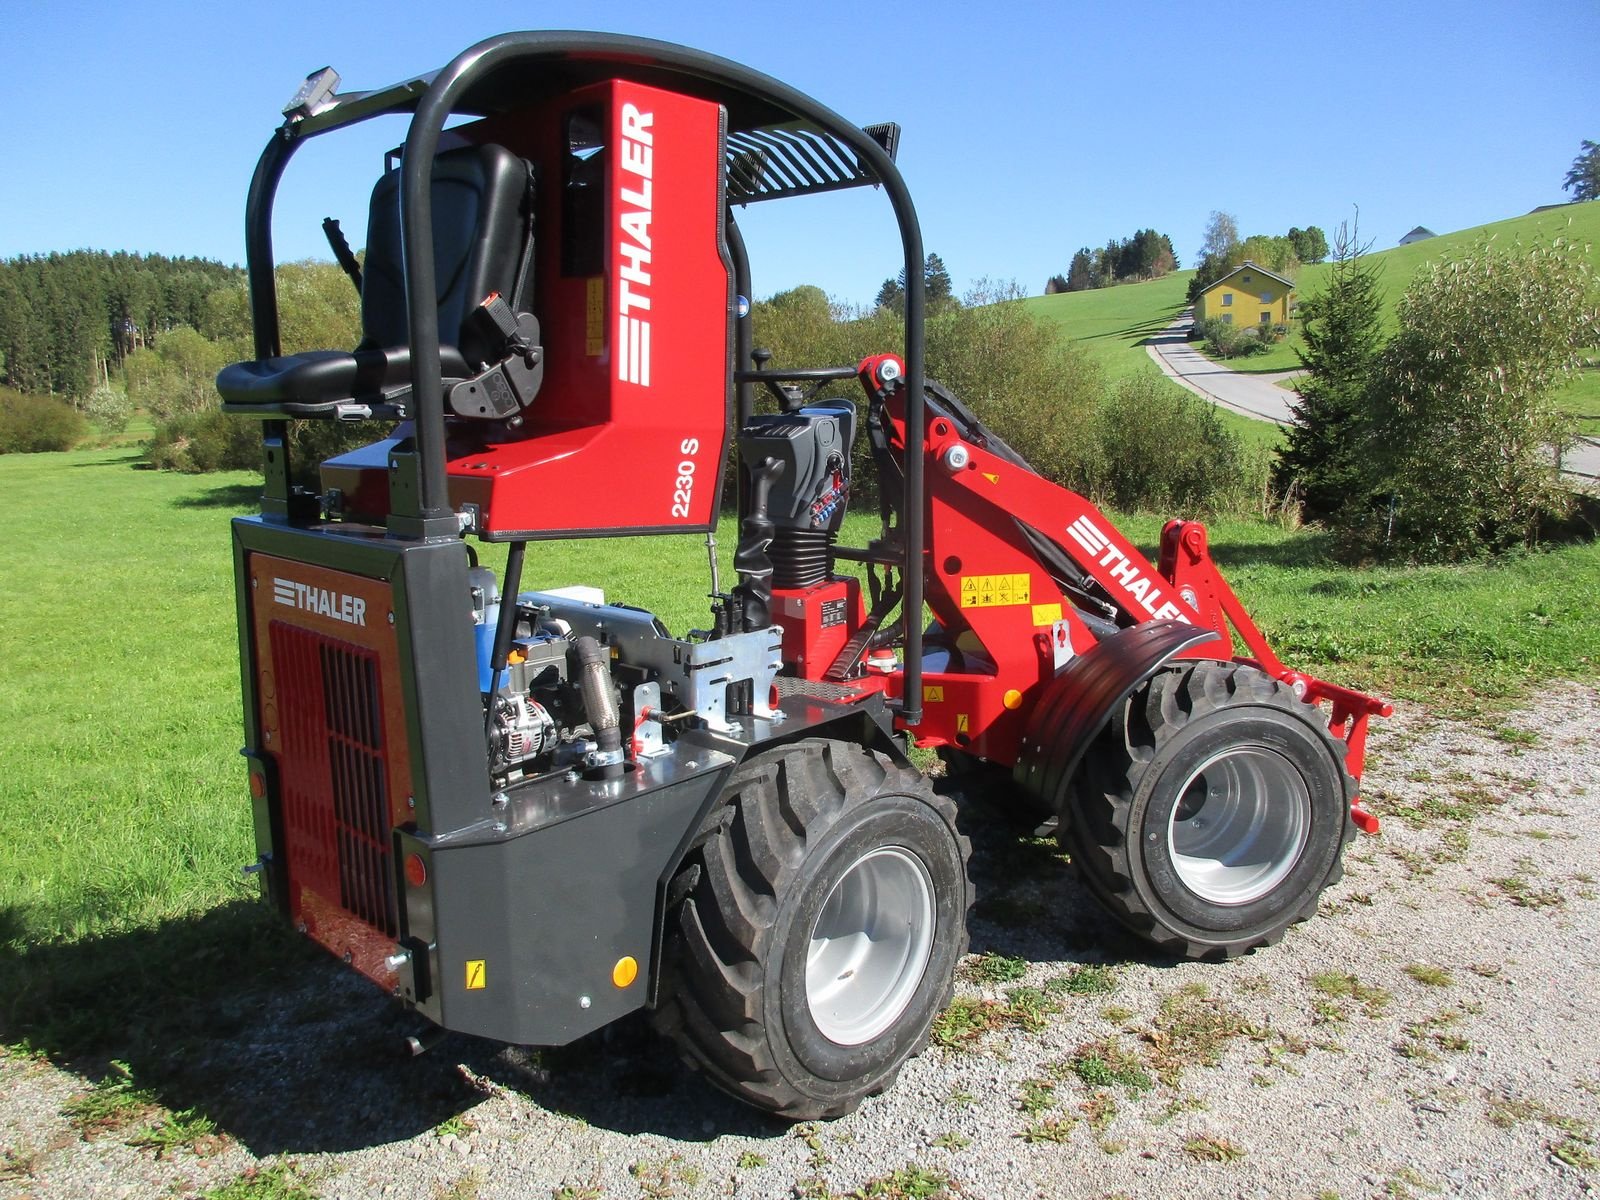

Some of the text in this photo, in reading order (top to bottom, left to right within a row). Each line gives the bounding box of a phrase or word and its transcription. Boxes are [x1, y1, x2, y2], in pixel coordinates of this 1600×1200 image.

[620, 103, 654, 317] THALER
[671, 438, 700, 518] 2230 S
[295, 582, 366, 627] THALER
[1099, 543, 1192, 625] THALE
